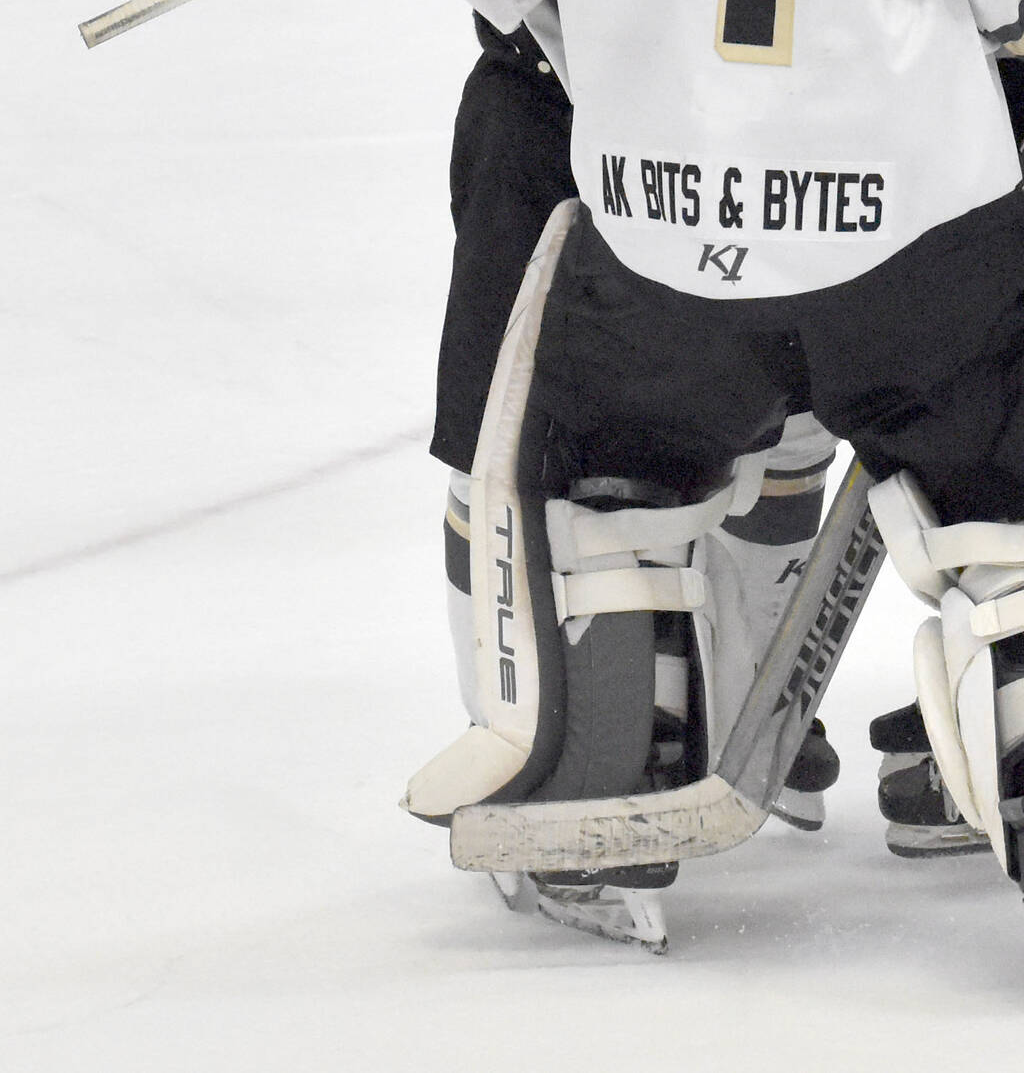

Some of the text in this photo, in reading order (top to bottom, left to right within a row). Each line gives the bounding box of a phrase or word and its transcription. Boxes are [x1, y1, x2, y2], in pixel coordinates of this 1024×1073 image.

[601, 153, 885, 233] AK BITS & BYTES
[697, 243, 750, 285] K1
[494, 503, 517, 705] TRUE
